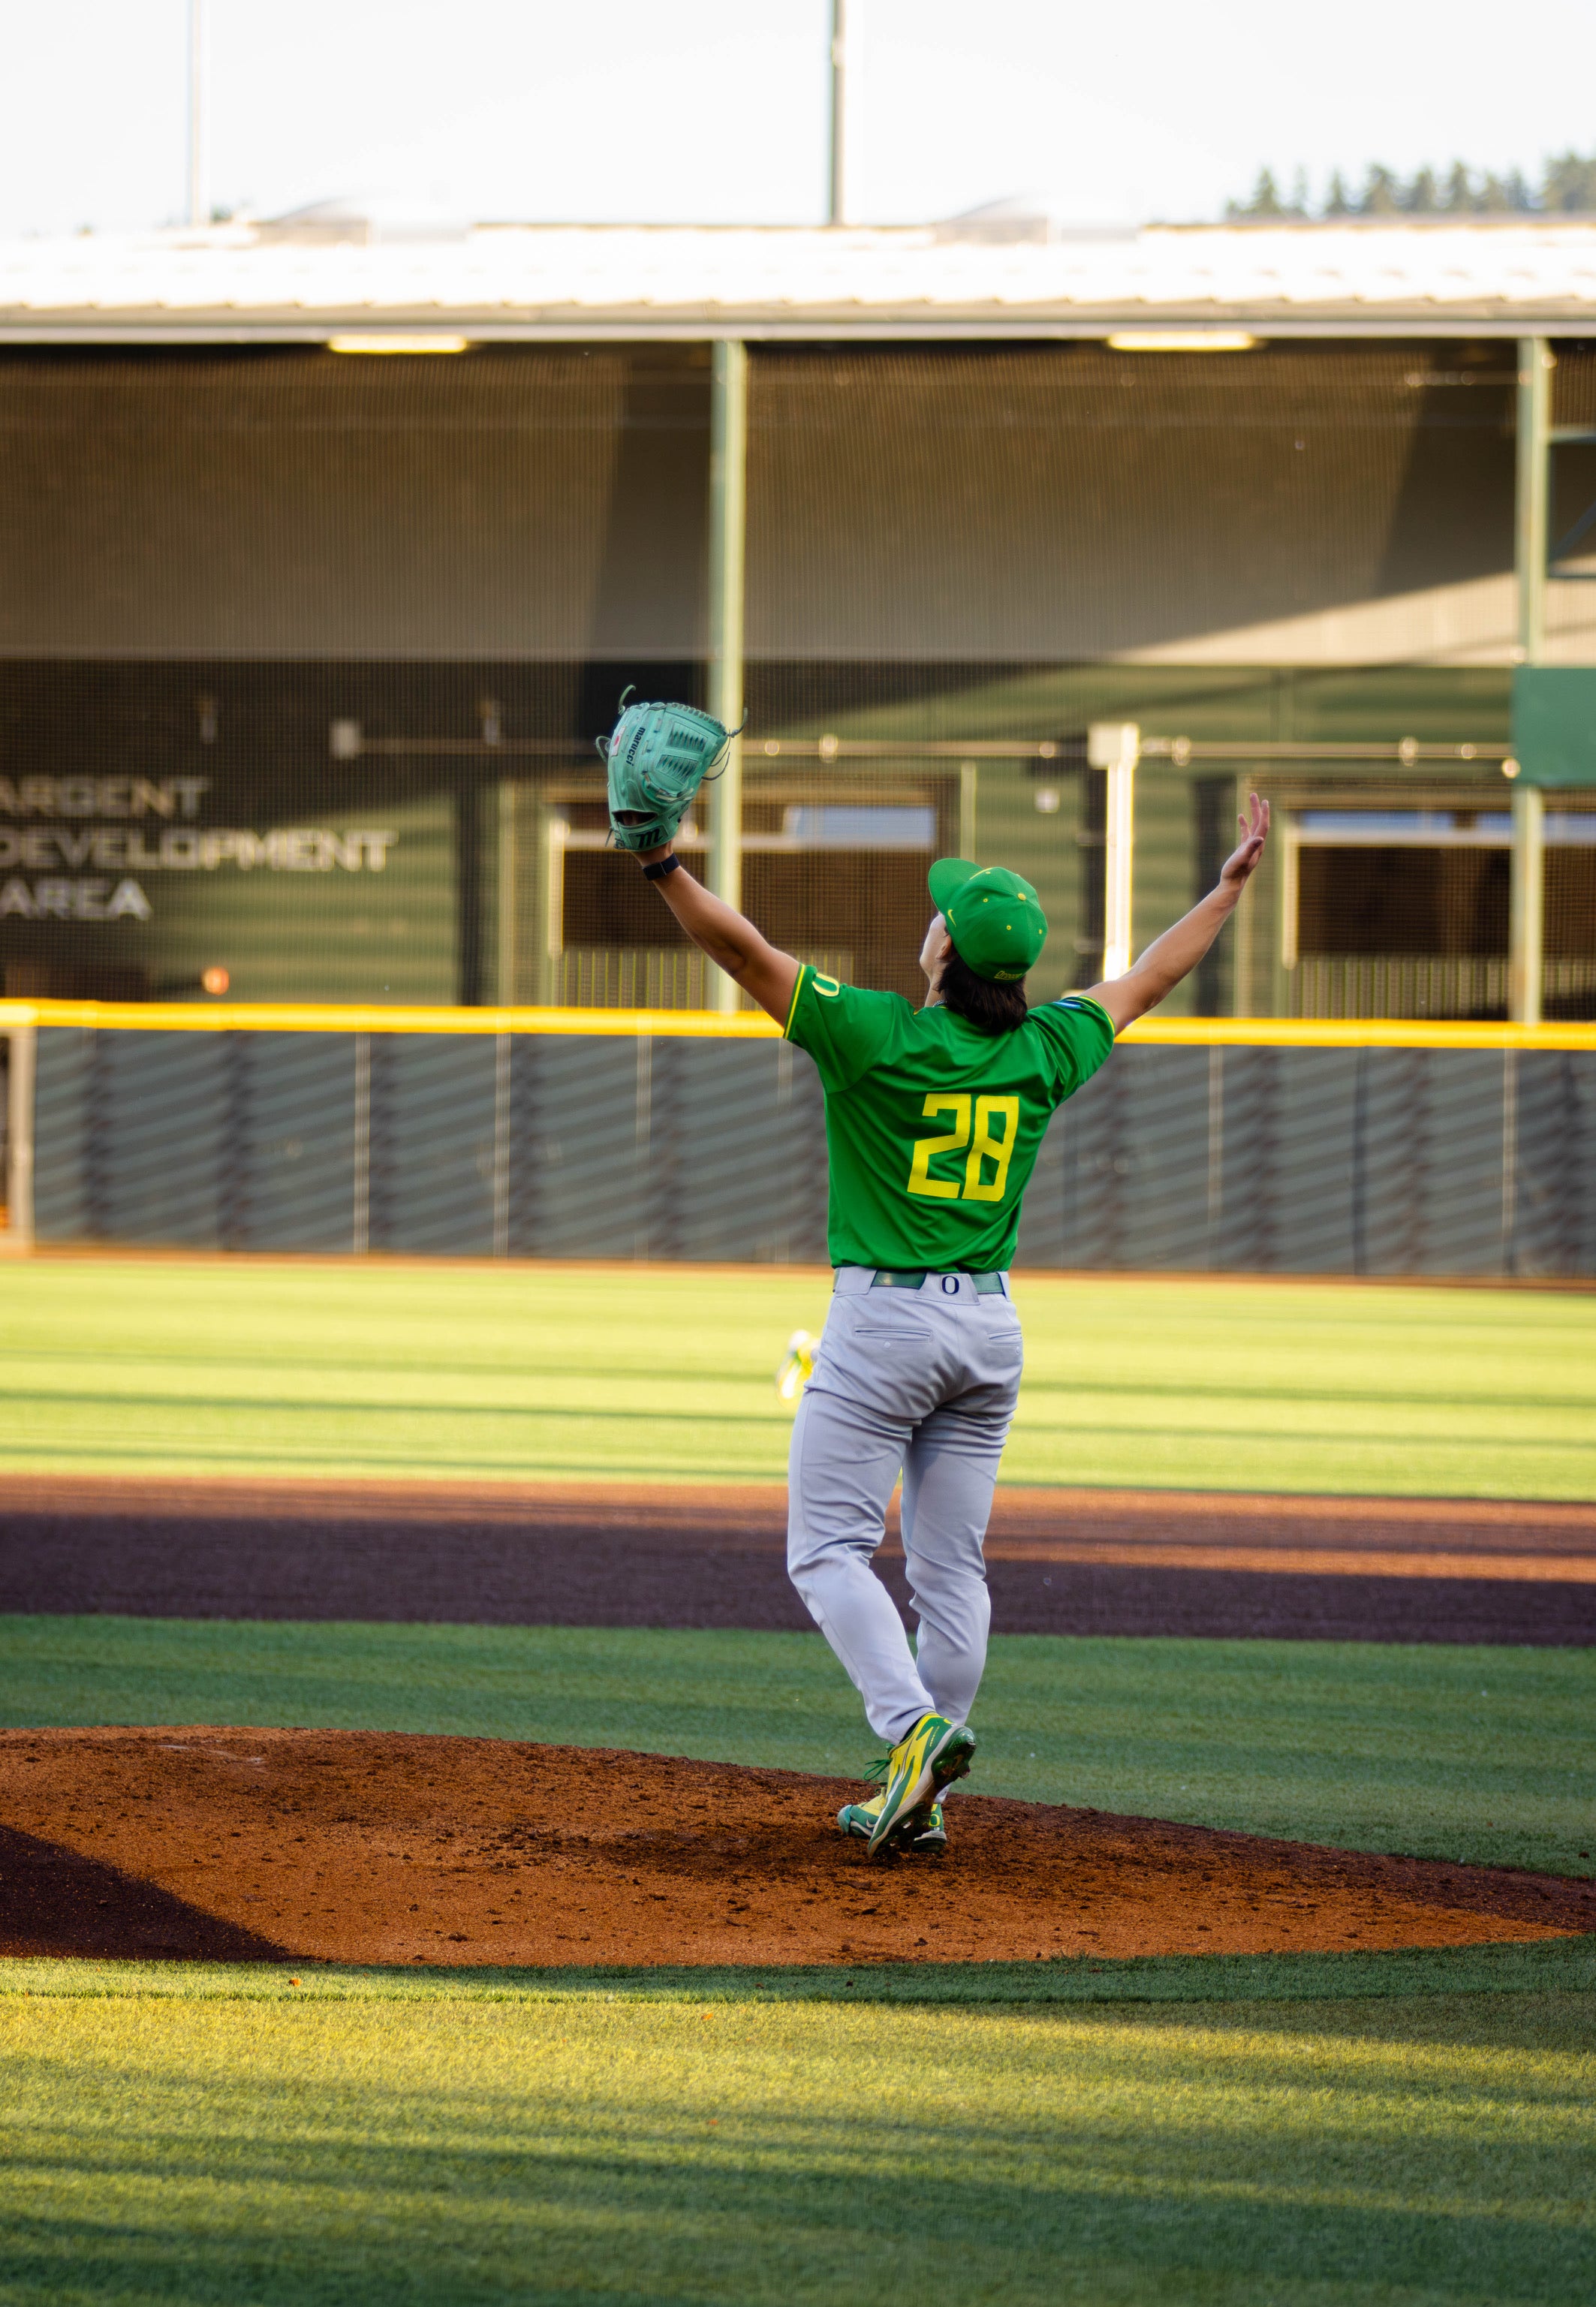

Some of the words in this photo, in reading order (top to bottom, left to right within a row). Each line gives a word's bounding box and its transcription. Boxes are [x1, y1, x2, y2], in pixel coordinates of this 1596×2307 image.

[626, 727, 646, 766] marucci
[0, 878, 153, 920] AREA
[907, 1092, 1019, 1202] 28
[941, 1275, 960, 1295] O
